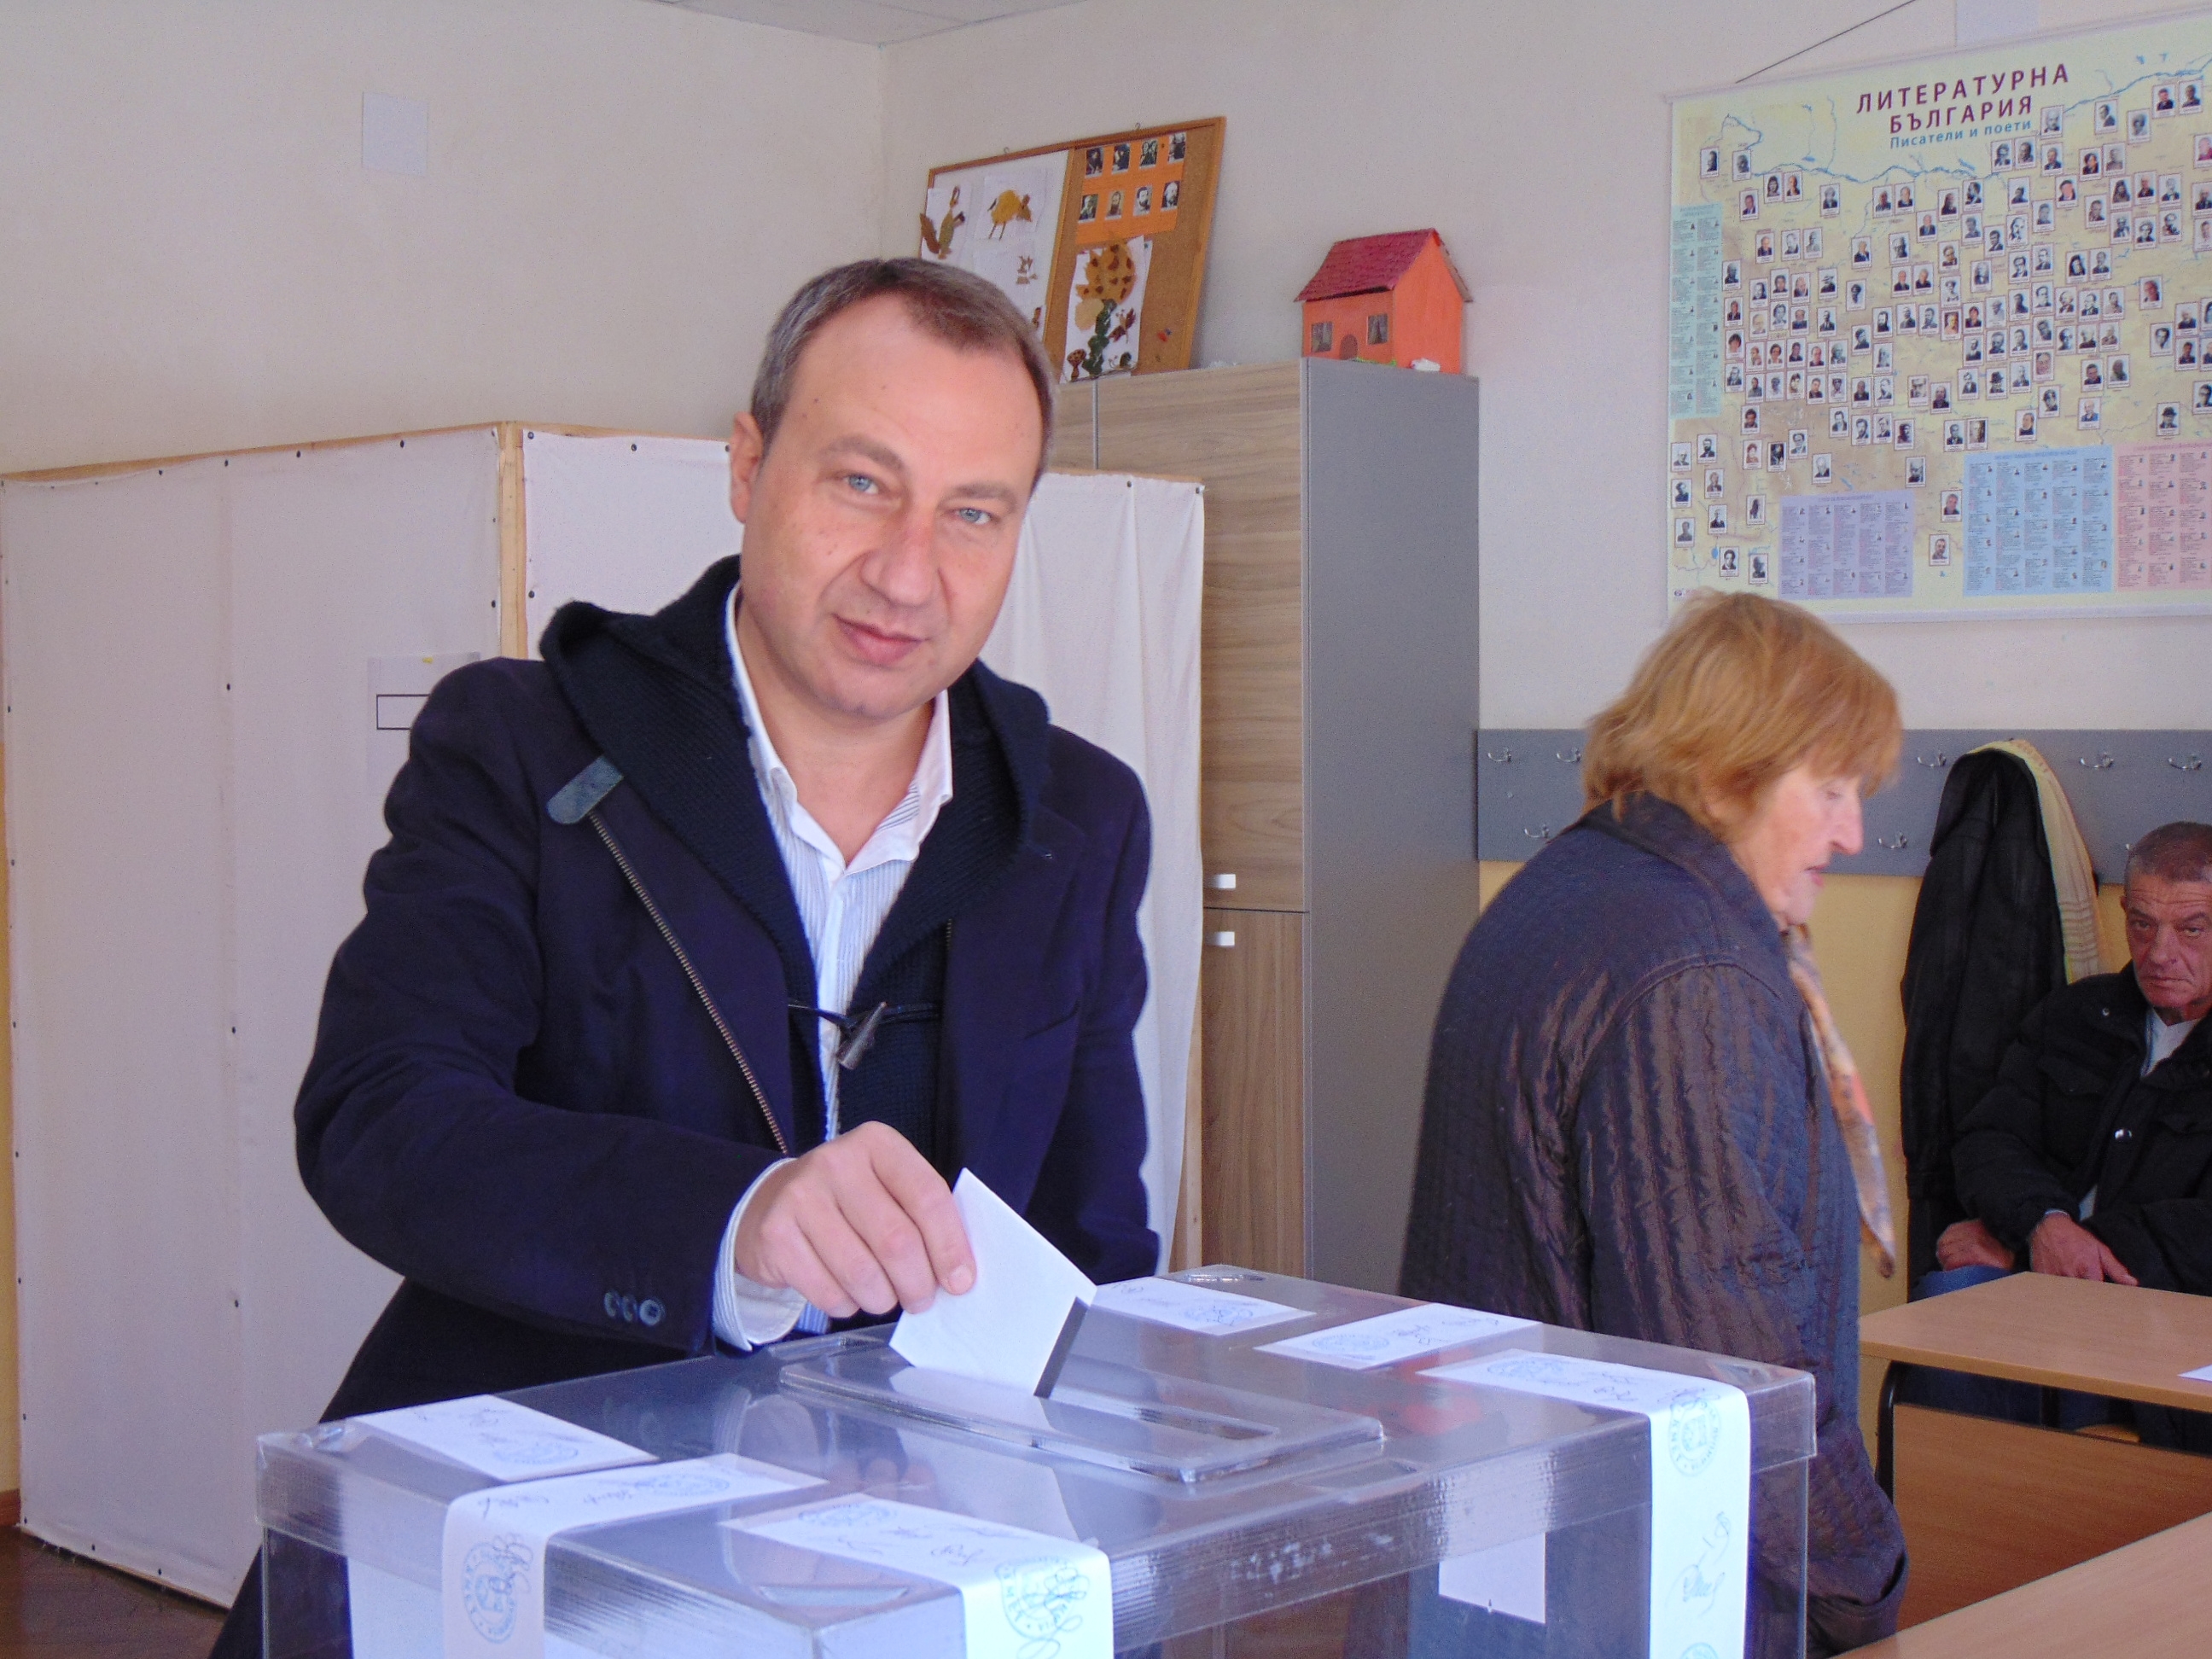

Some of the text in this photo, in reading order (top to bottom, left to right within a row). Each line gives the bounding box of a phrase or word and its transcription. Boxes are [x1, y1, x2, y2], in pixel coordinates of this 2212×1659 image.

[1856, 63, 2069, 114] ЛИТЕРАТУРНА
[1889, 95, 2032, 134] БЪЛГАРИЯ
[1890, 120, 2031, 149] Писатели и поети
